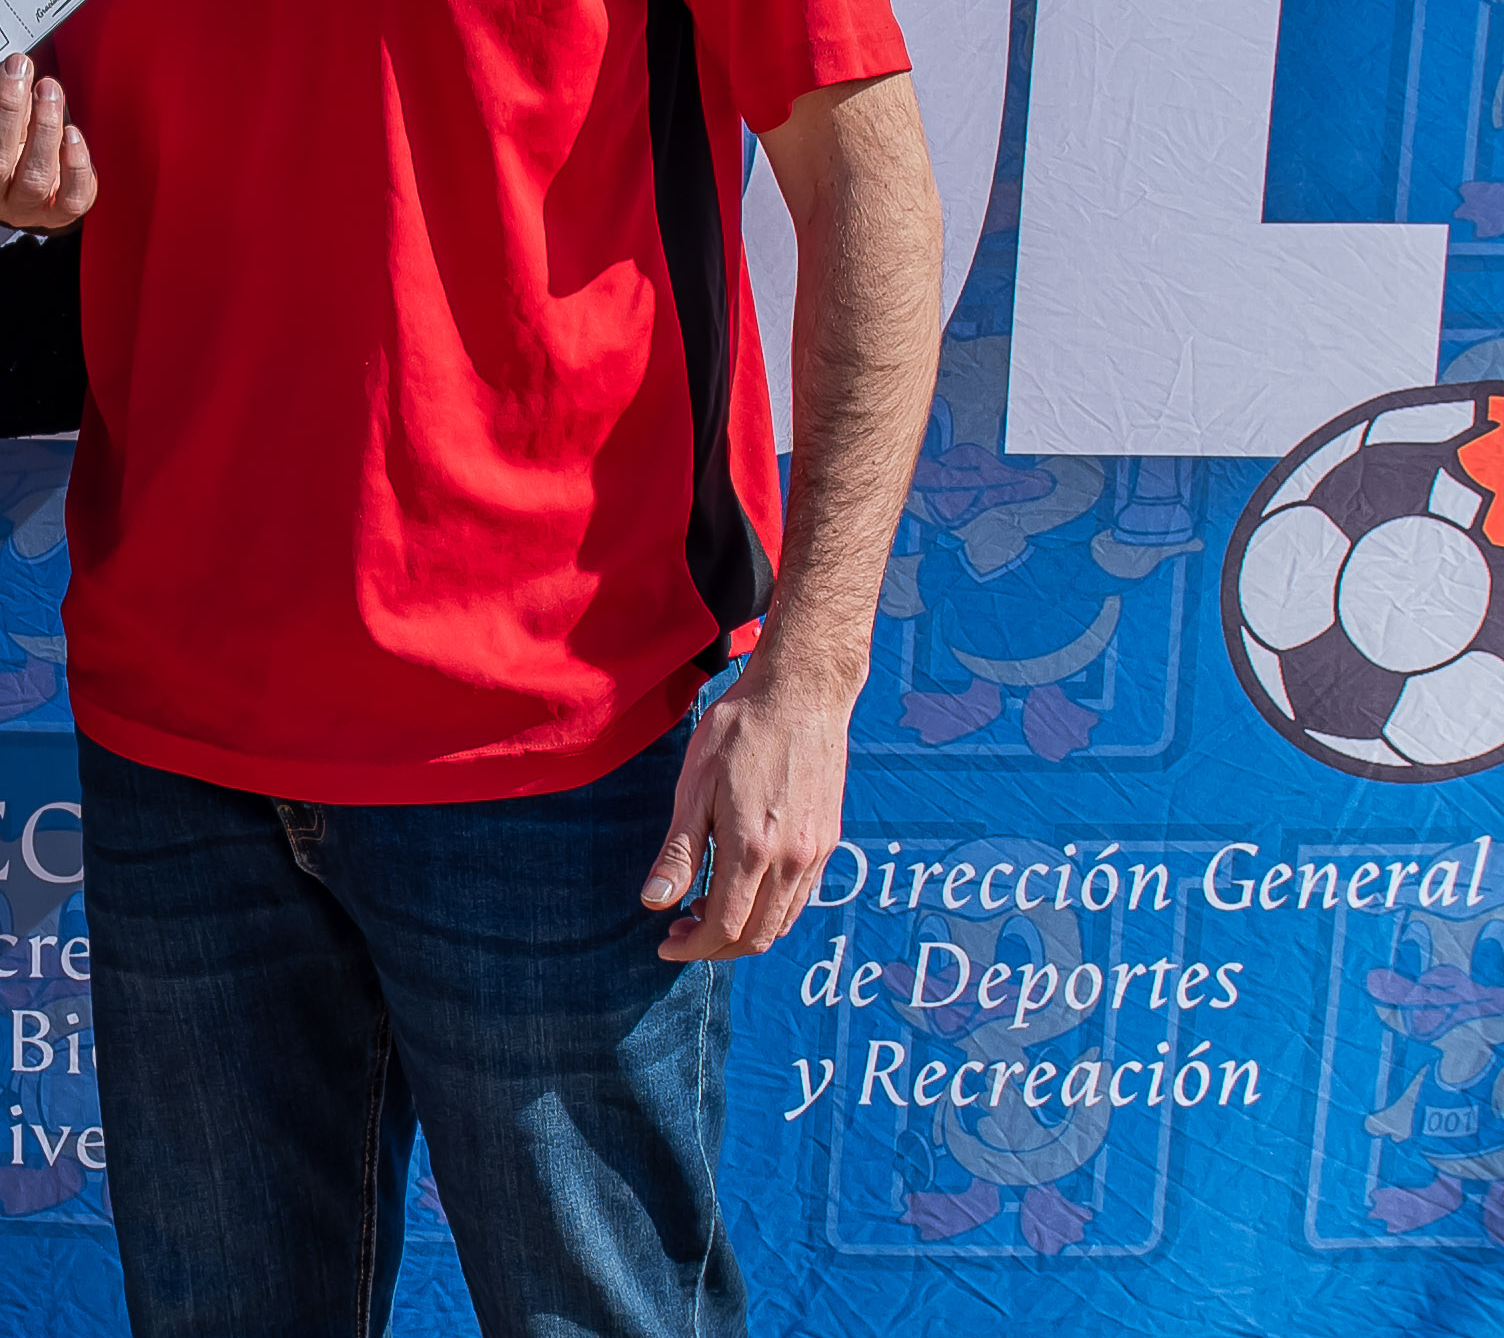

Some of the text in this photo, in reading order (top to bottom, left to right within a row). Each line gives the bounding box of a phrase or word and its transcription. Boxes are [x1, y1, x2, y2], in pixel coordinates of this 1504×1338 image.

[807, 834, 1488, 912] Dirección General
[800, 935, 1244, 1031] de Deportes
[783, 1039, 1263, 1122] y Recreación
